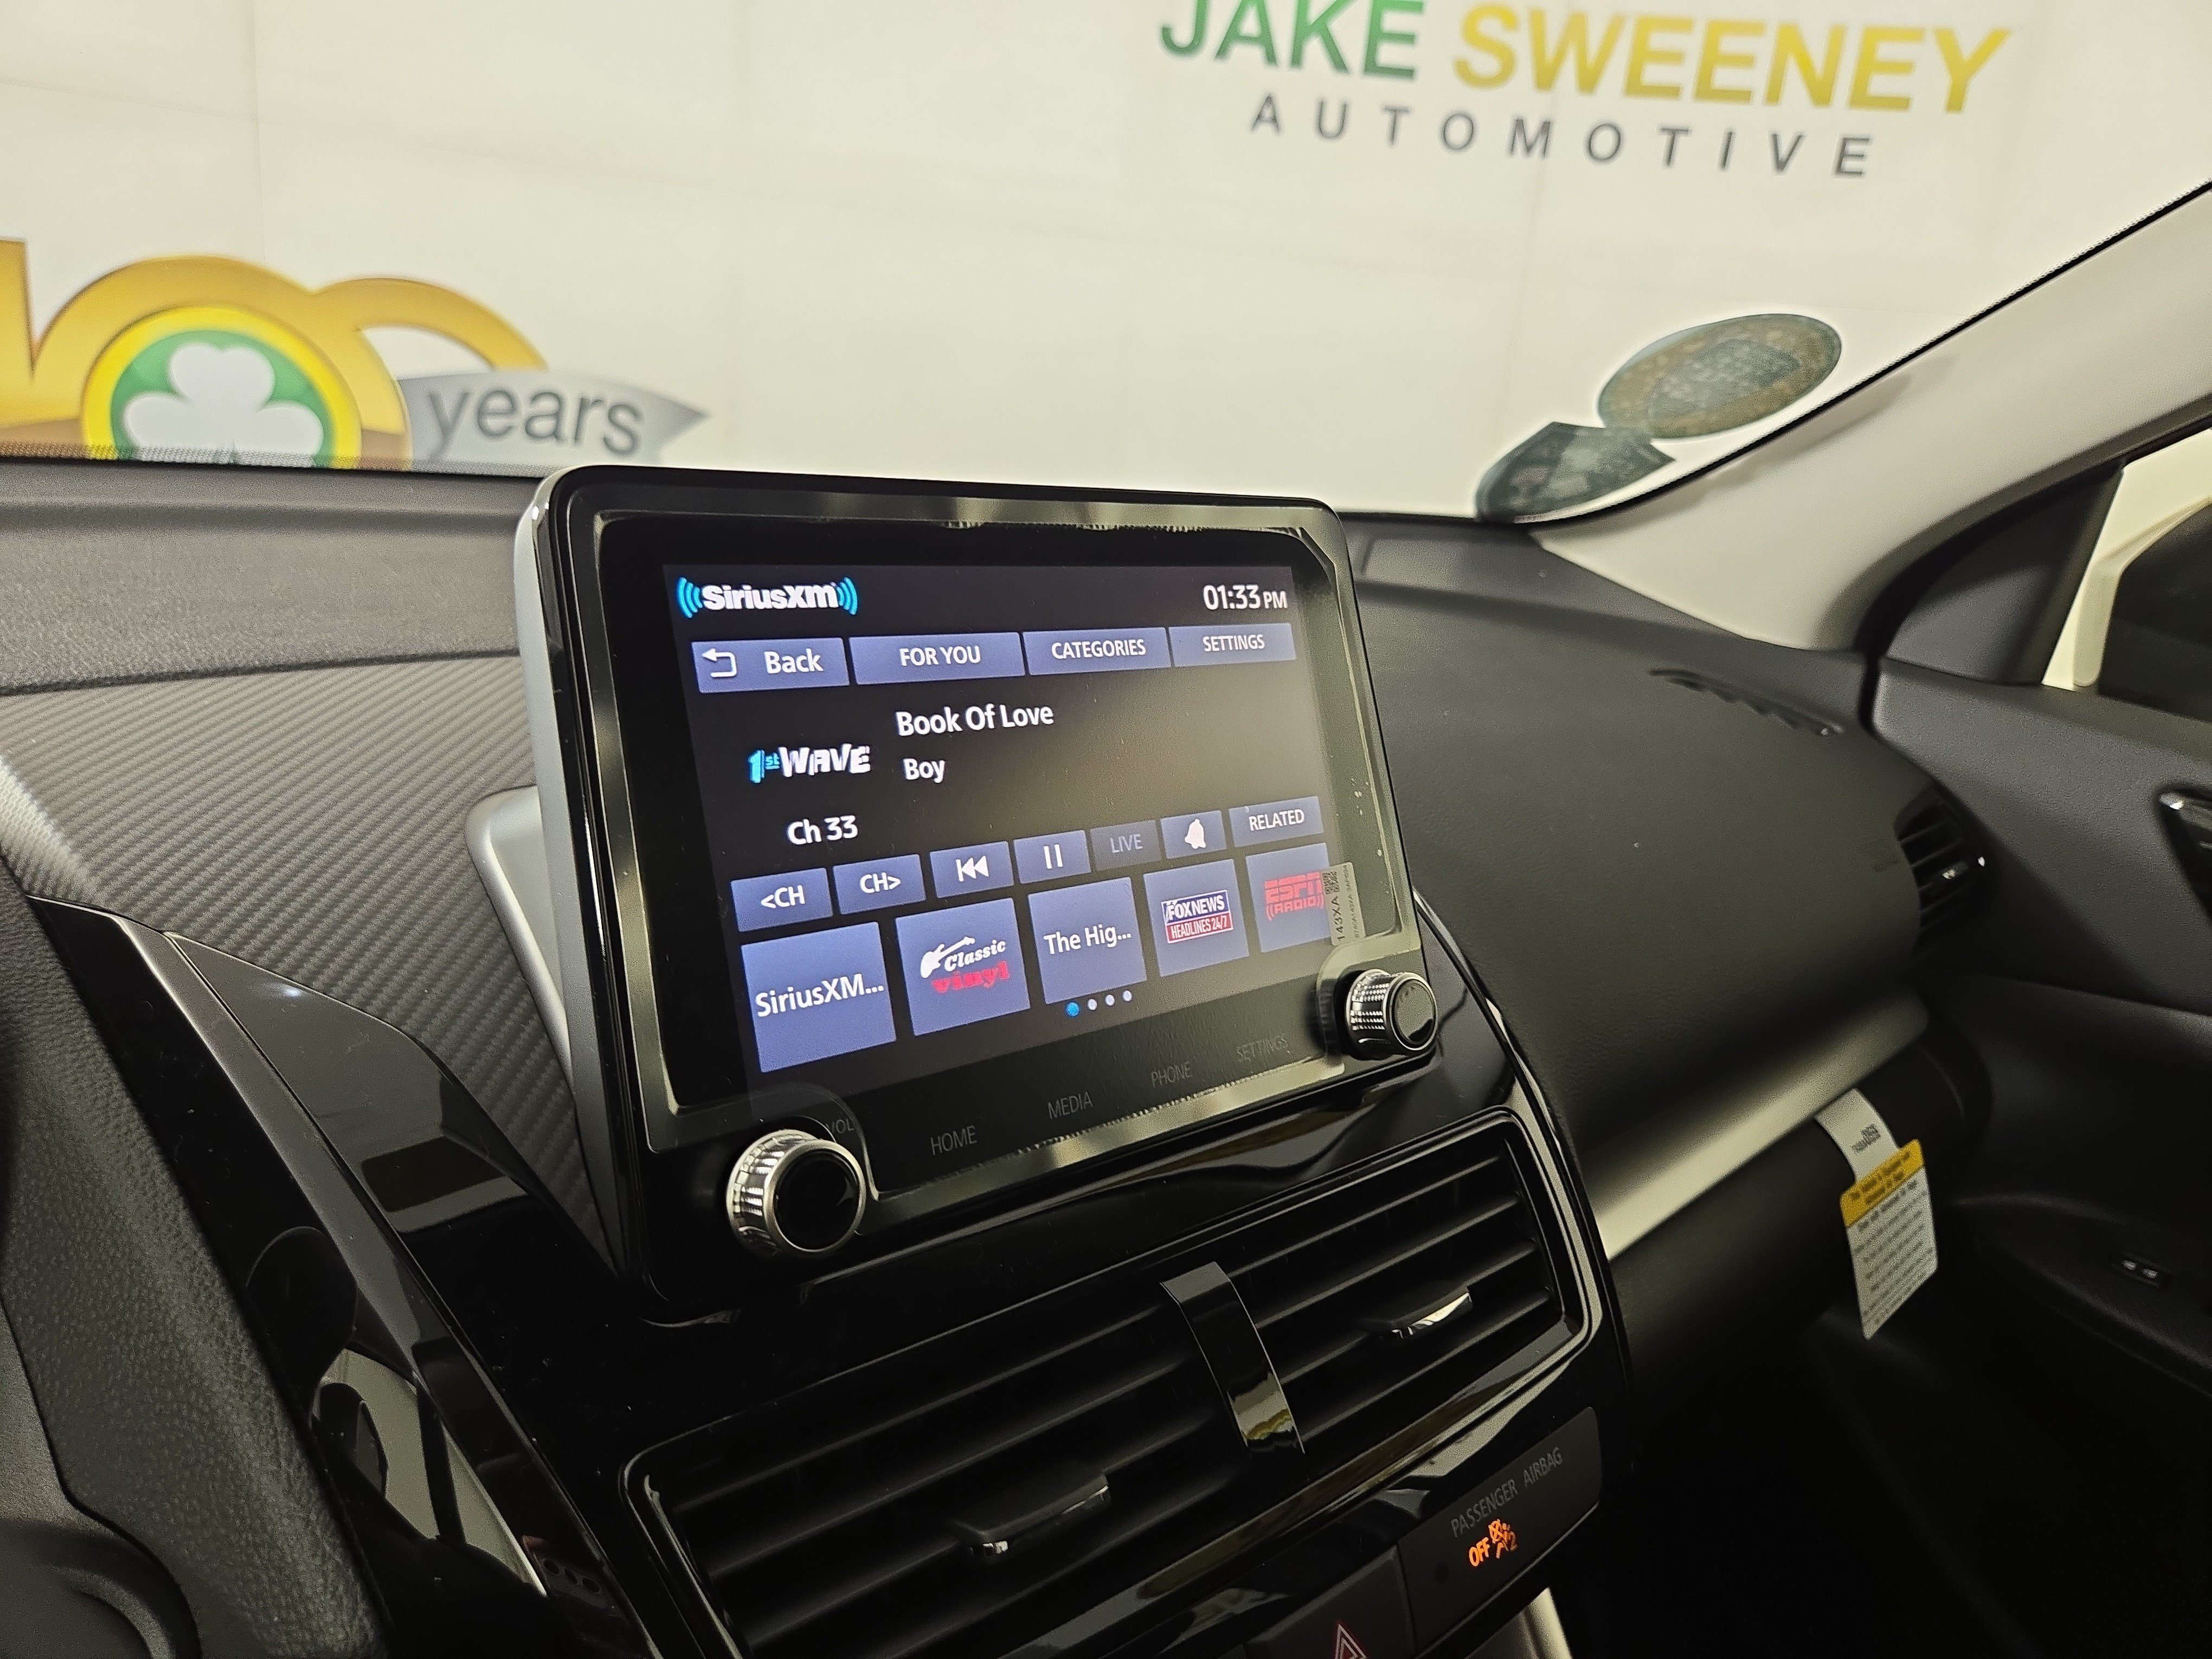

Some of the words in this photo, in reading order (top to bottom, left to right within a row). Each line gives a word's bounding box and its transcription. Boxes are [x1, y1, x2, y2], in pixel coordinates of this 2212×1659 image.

[1159, 0, 1425, 81] JAKE
[1452, 2, 2011, 114] SWEENEY
[1250, 92, 1872, 178] AUTOMOTIVE
[427, 383, 645, 457] years
[1203, 584, 1261, 610] 01:33
[1264, 590, 1288, 609] PM
[899, 647, 939, 667] FOR
[942, 645, 981, 664] YOU
[1051, 638, 1146, 659] CATEGORIES
[1203, 634, 1265, 652] SETTINGS
[764, 648, 824, 674] Back
[896, 706, 962, 736] Book
[965, 703, 996, 731] Of
[1001, 705, 1054, 729] Love
[903, 758, 946, 784] Boy
[787, 818, 822, 845] Ch
[824, 815, 858, 841] 33
[1249, 808, 1305, 831] RELATED
[1111, 833, 1143, 854] LIVE
[1264, 871, 1323, 905] ESPN
[1171, 918, 1212, 940] HEADLINES
[1211, 915, 1227, 930] 24/7
[1331, 896, 1346, 942] 143XA
[944, 939, 1006, 972] Classic
[1044, 931, 1081, 955] The
[1236, 1036, 1289, 1063] SETTINGS
[1150, 1060, 1192, 1088] PHONE
[1047, 1091, 1094, 1120] MEDIA
[930, 1124, 978, 1156] HOME
[1450, 1478, 1518, 1538] PASSENGER
[1523, 1446, 1563, 1488] AIRBAG
[1468, 1536, 1490, 1567] OFF
